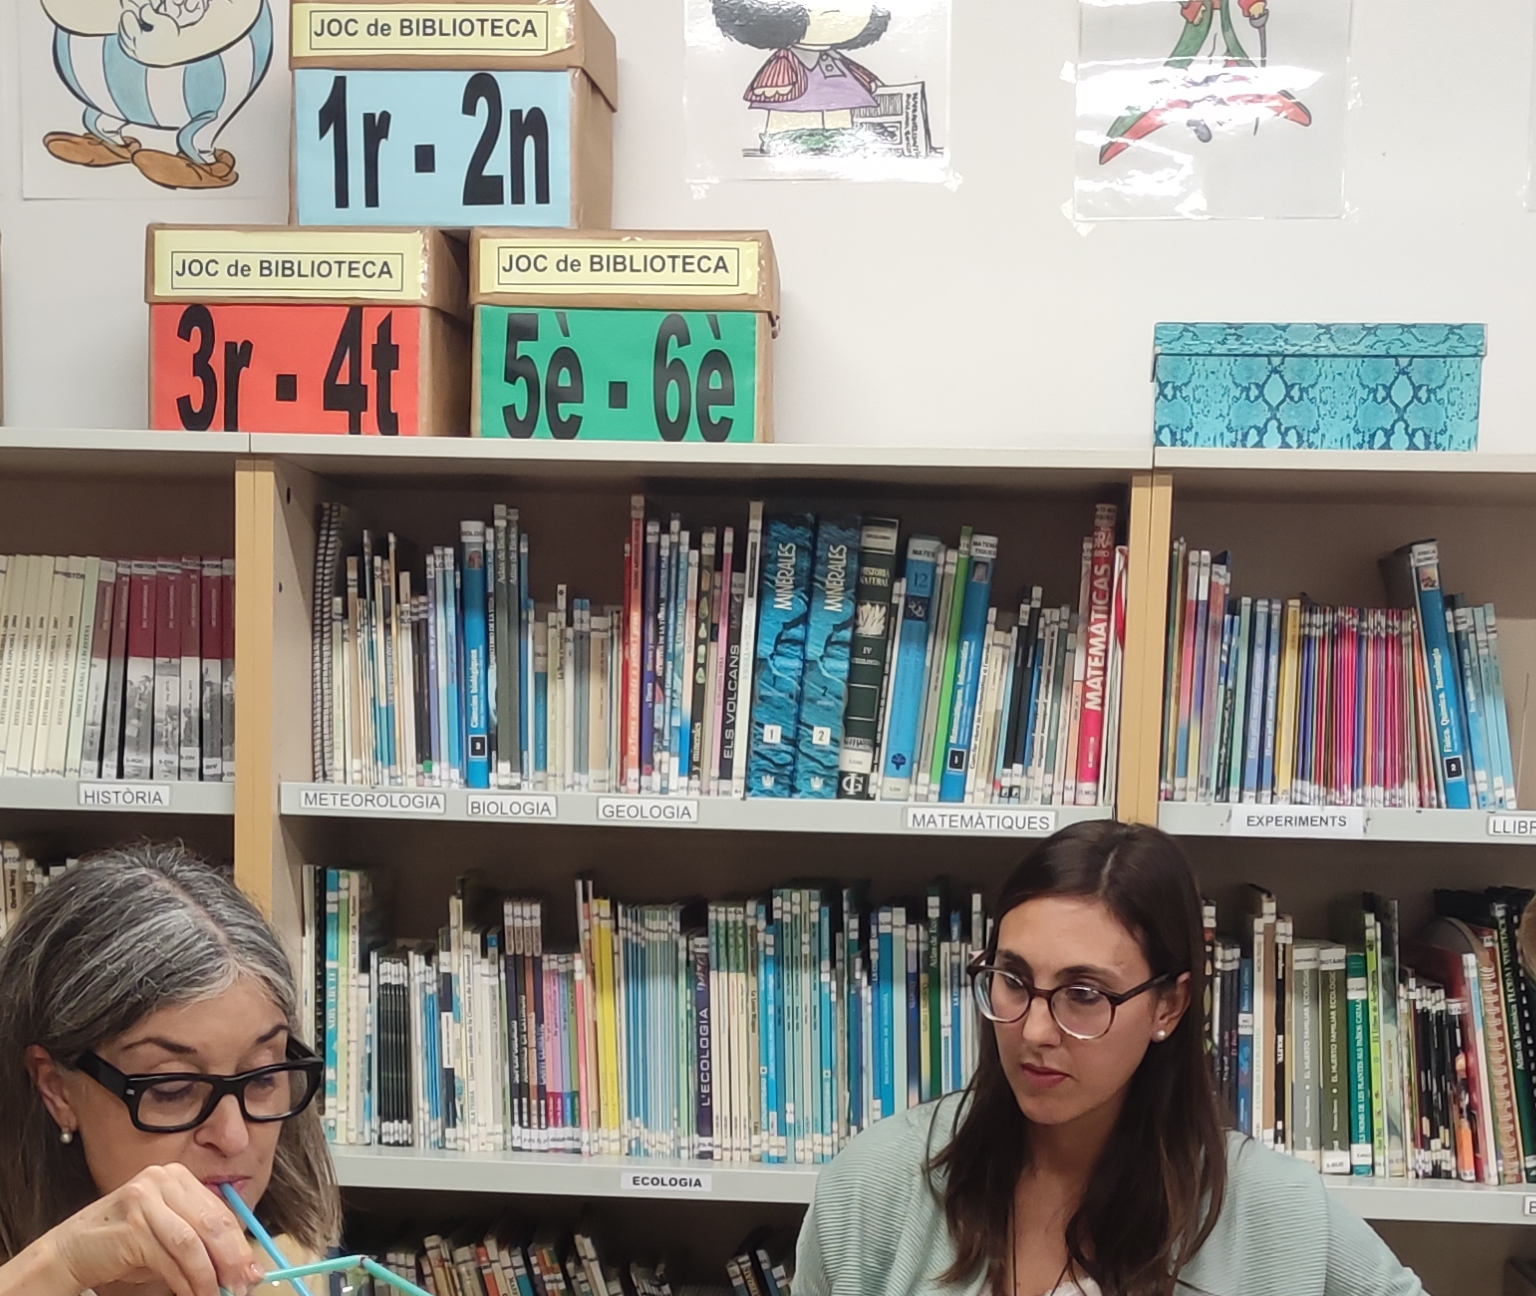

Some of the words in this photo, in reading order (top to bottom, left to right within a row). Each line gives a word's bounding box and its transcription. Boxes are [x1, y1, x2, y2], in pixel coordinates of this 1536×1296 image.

[313, 19, 362, 39] JOC
[365, 19, 391, 38] de
[399, 18, 537, 39] BIBLIOTECA
[318, 75, 390, 208] 1r
[462, 72, 550, 206] 2n
[175, 259, 222, 279] JOC
[228, 260, 251, 279] de
[259, 259, 393, 280] BIBLIOTECA
[502, 253, 548, 273] JOC
[556, 253, 582, 272] de
[590, 253, 730, 274] BIBLIOTECA
[176, 304, 252, 431] 3r
[323, 306, 399, 434] 4t
[502, 312, 583, 439] 5è
[653, 314, 735, 441] 6è
[774, 542, 797, 610] MINERALES
[824, 545, 848, 612] MINERALES
[913, 572, 928, 589] 12
[1085, 564, 1111, 711] MATEMÁTICAS
[725, 644, 740, 723] VOLCANS
[724, 729, 734, 759] ELS
[84, 788, 163, 805] HISTÒRIA
[304, 793, 440, 809] METEOROLOGIA
[470, 800, 551, 815] BIOLOGIA
[602, 803, 692, 819] GEOLOGIA
[913, 811, 1049, 830] MATEMÀTIQUES
[1247, 816, 1347, 827] EXPERIMENTS
[698, 1008, 710, 1106] L'ECOLOGIA
[632, 1176, 702, 1187] ECOLOGIA
